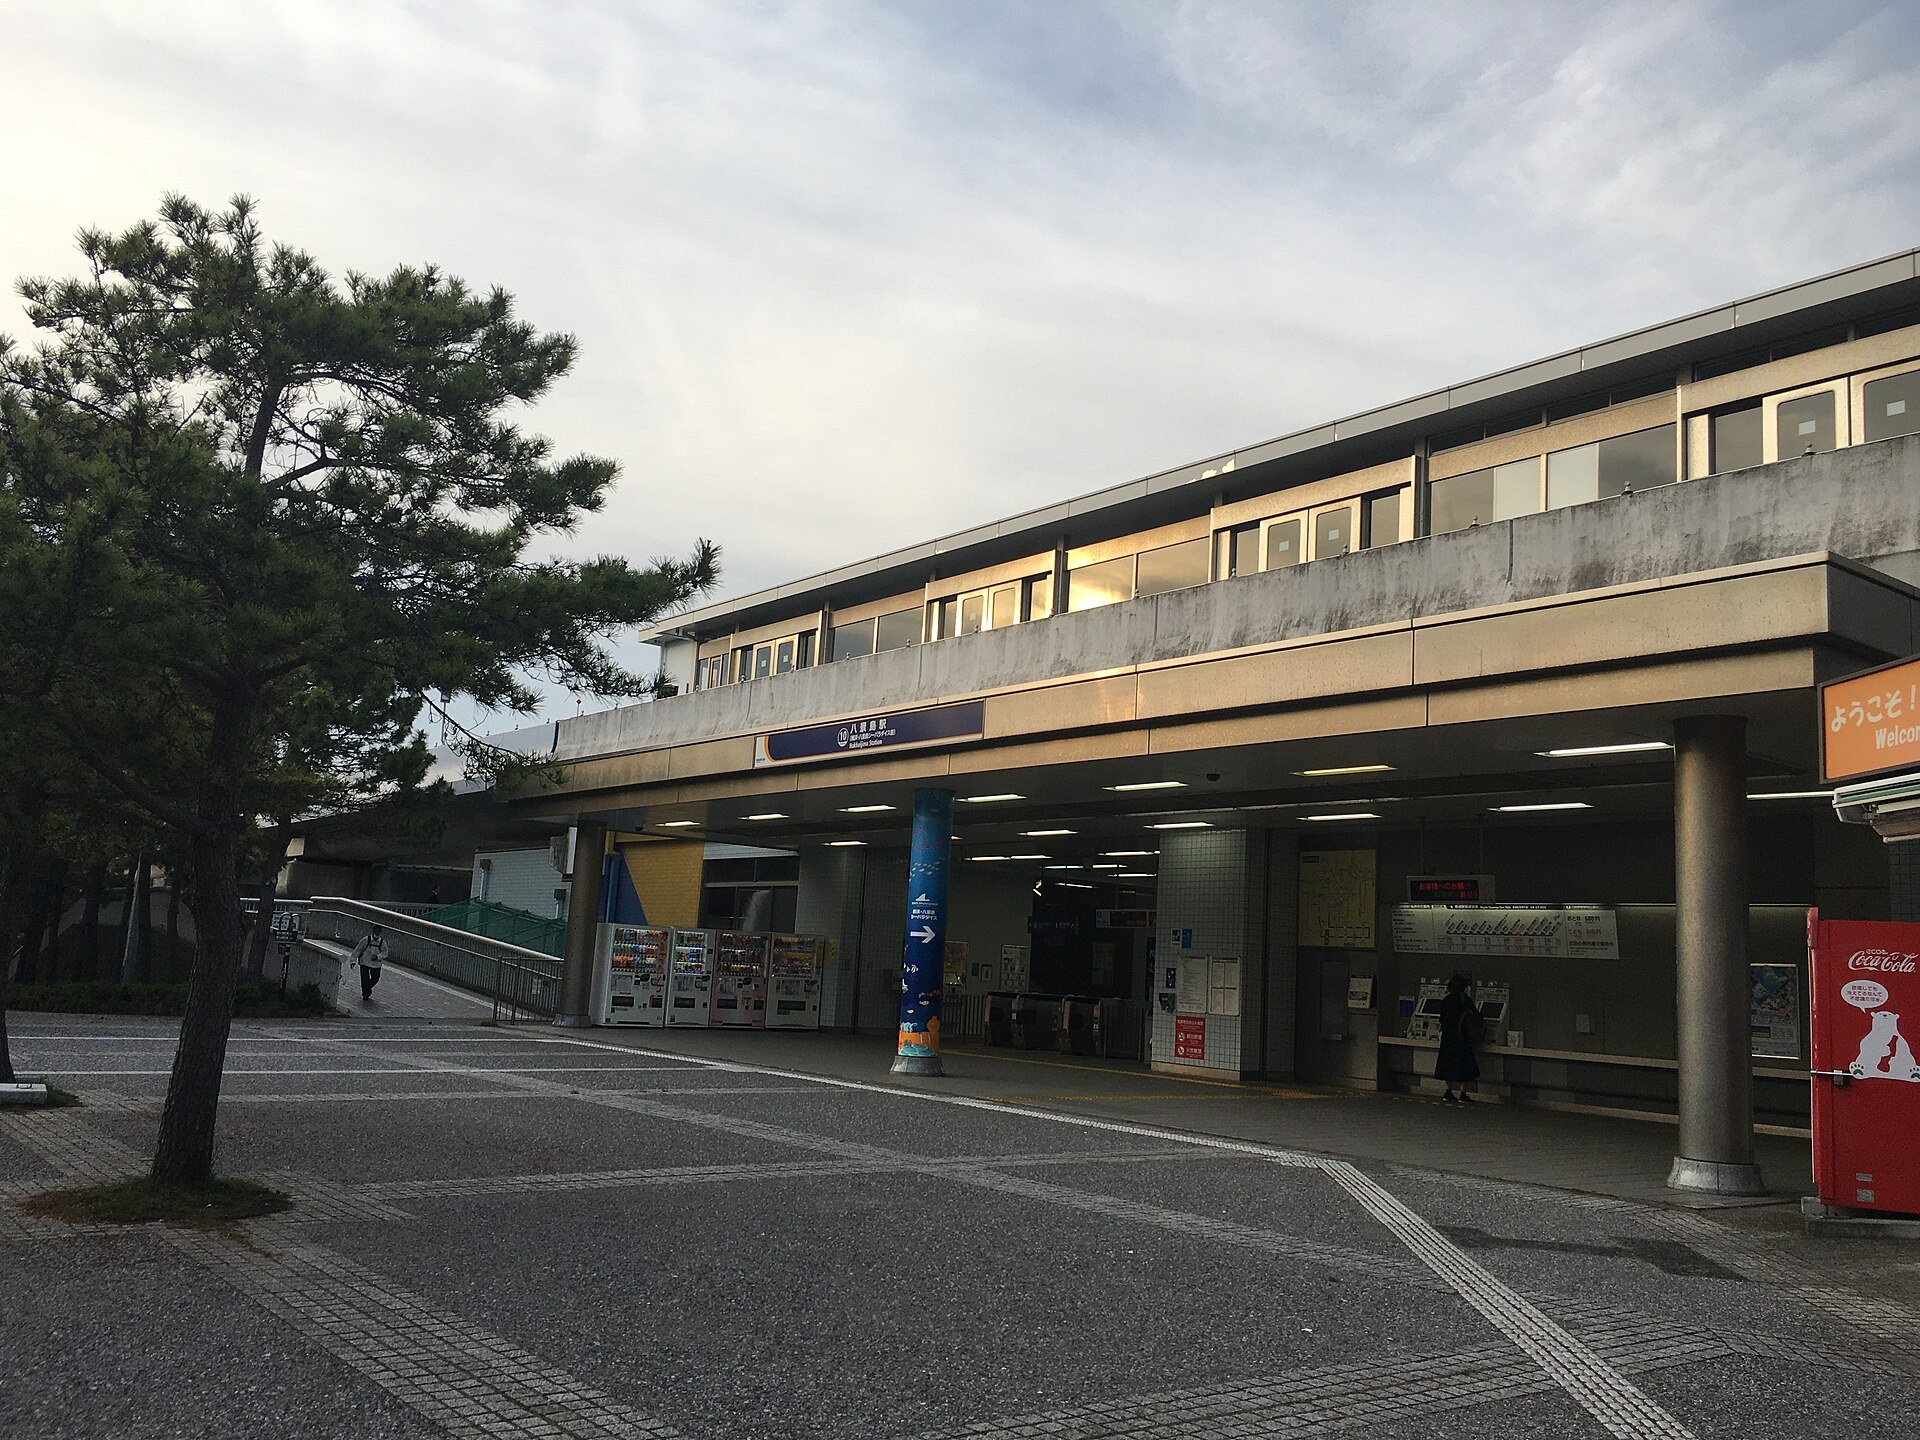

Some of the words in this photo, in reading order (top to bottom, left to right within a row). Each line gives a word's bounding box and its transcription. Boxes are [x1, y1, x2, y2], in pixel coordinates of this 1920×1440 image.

[850, 719, 886, 733] 八景島駅
[840, 730, 847, 741] 10
[1848, 950, 1919, 973] Coca-Cola
